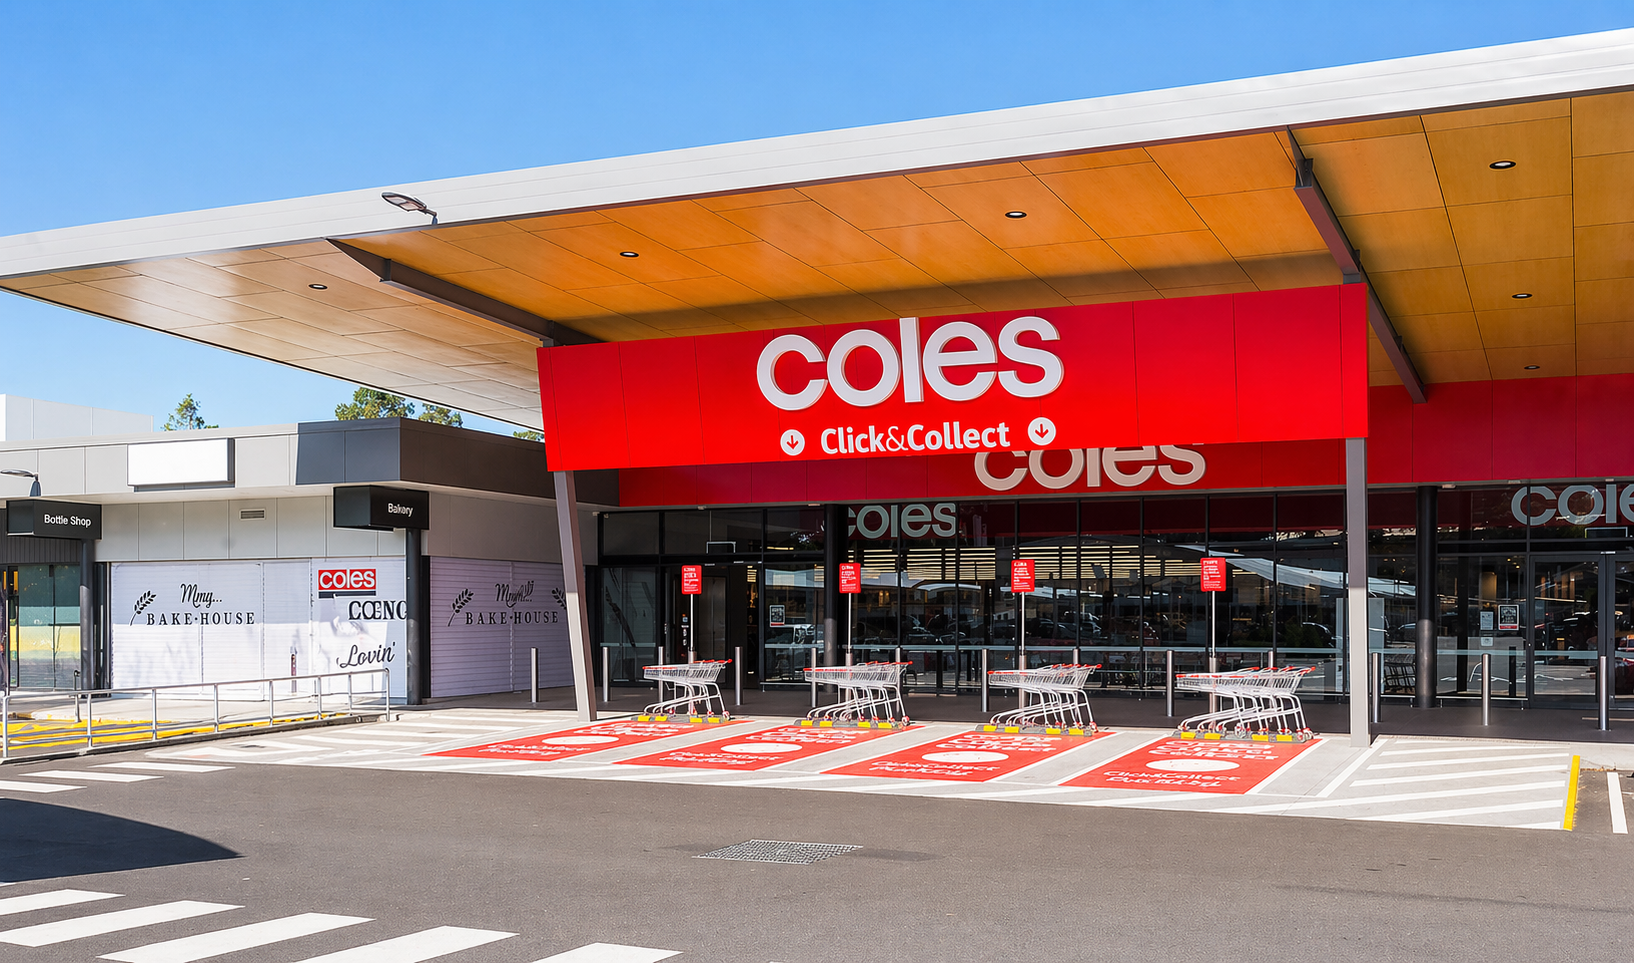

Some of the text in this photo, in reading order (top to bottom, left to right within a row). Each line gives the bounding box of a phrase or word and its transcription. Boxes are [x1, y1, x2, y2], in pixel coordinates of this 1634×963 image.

[757, 317, 1064, 411] coles
[820, 421, 1010, 454] Click&Collect
[70, 516, 92, 528] Shop
[319, 569, 376, 588] coles
